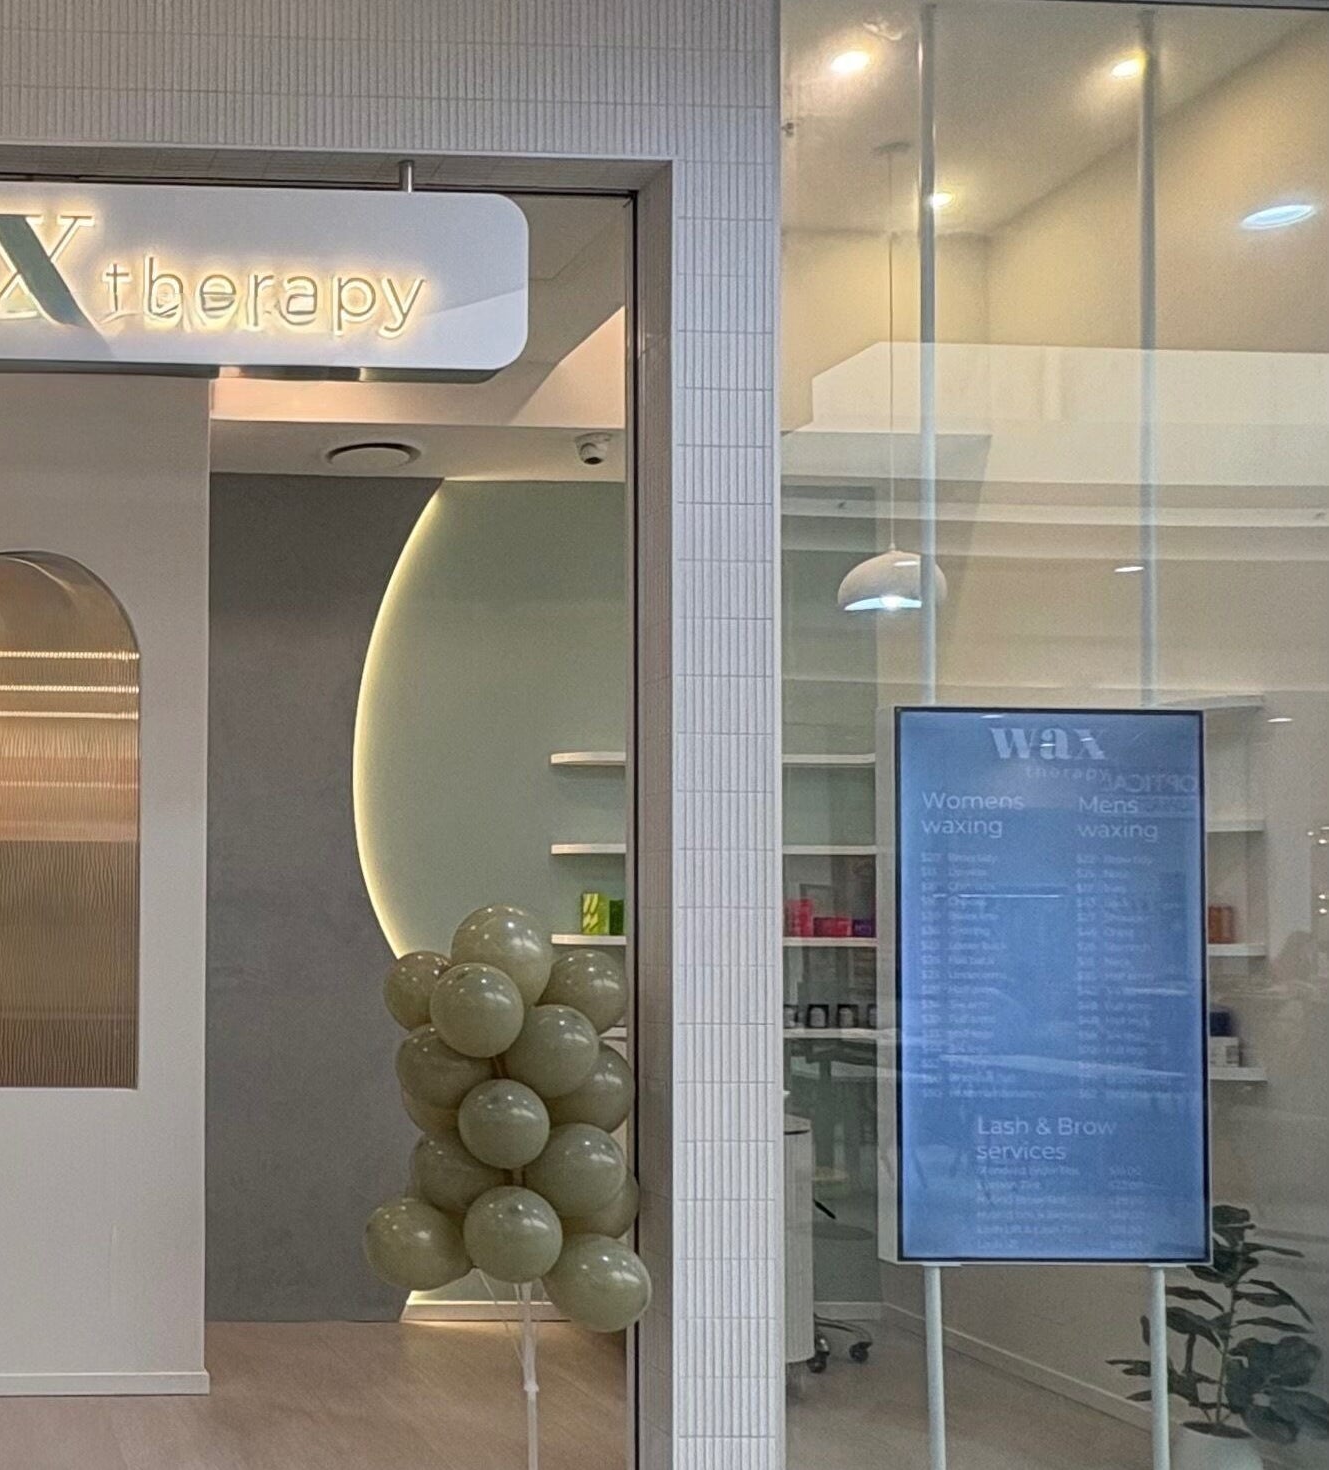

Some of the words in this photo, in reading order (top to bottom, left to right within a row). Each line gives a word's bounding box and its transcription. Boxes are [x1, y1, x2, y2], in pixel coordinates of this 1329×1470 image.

[101, 256, 427, 338] therapy
[990, 726, 1109, 760] wax
[1025, 765, 1111, 783] therapy
[921, 791, 1026, 811] Womens
[1079, 796, 1139, 814] Mens
[920, 818, 1003, 839] waxing
[1077, 820, 1159, 843] waxing
[977, 1115, 1029, 1136] Lash
[1036, 1117, 1052, 1136] &
[1058, 1116, 1119, 1136] Brow
[975, 1141, 1068, 1161] services
